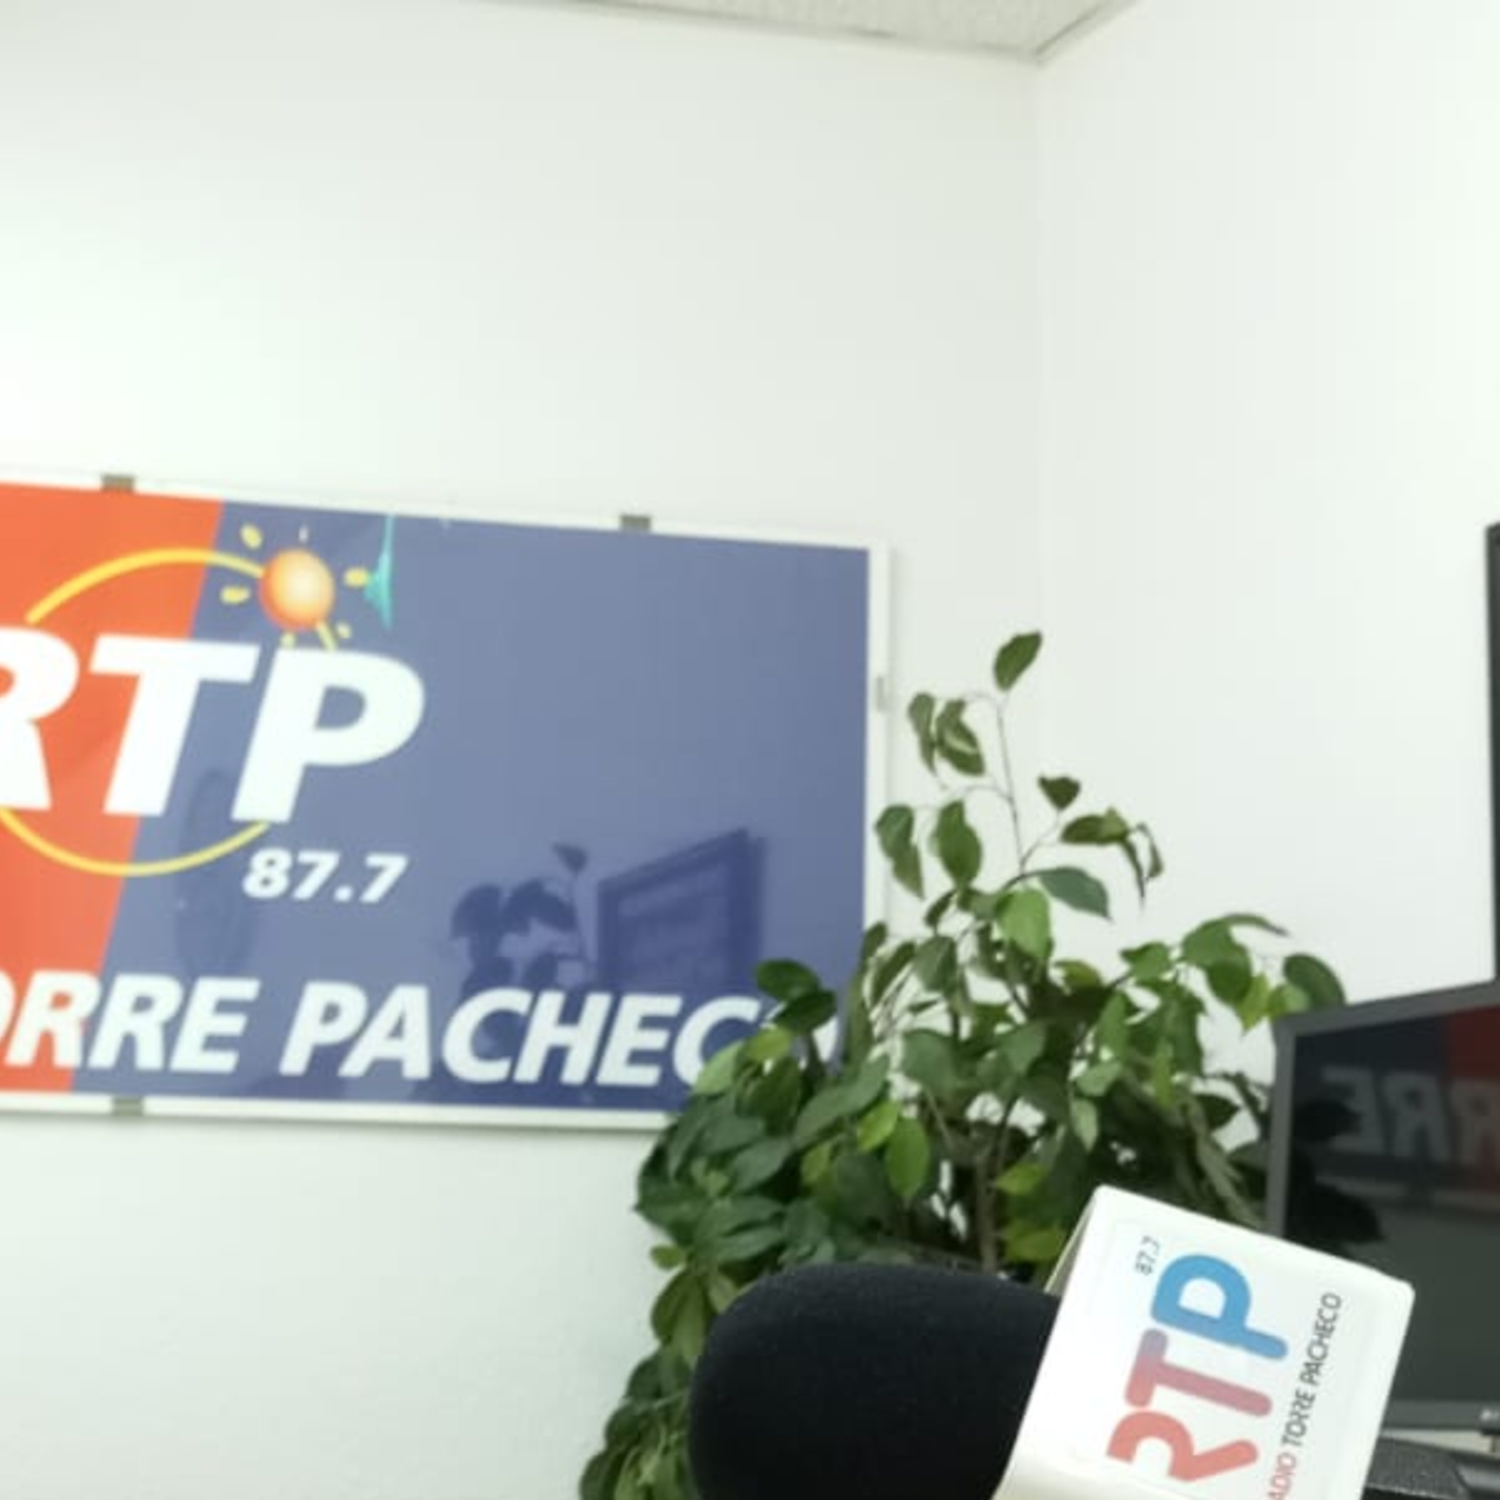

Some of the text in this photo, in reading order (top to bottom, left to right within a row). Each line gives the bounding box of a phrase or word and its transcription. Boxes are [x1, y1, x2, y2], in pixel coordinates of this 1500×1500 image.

[242, 847, 408, 903] 87.7
[280, 980, 838, 1088] PACHEC
[1135, 1235, 1160, 1276] 87.7
[1107, 1253, 1289, 1482] RTP
[1281, 1388, 1316, 1448] TORRE
[1299, 1292, 1342, 1386] PACHECO
